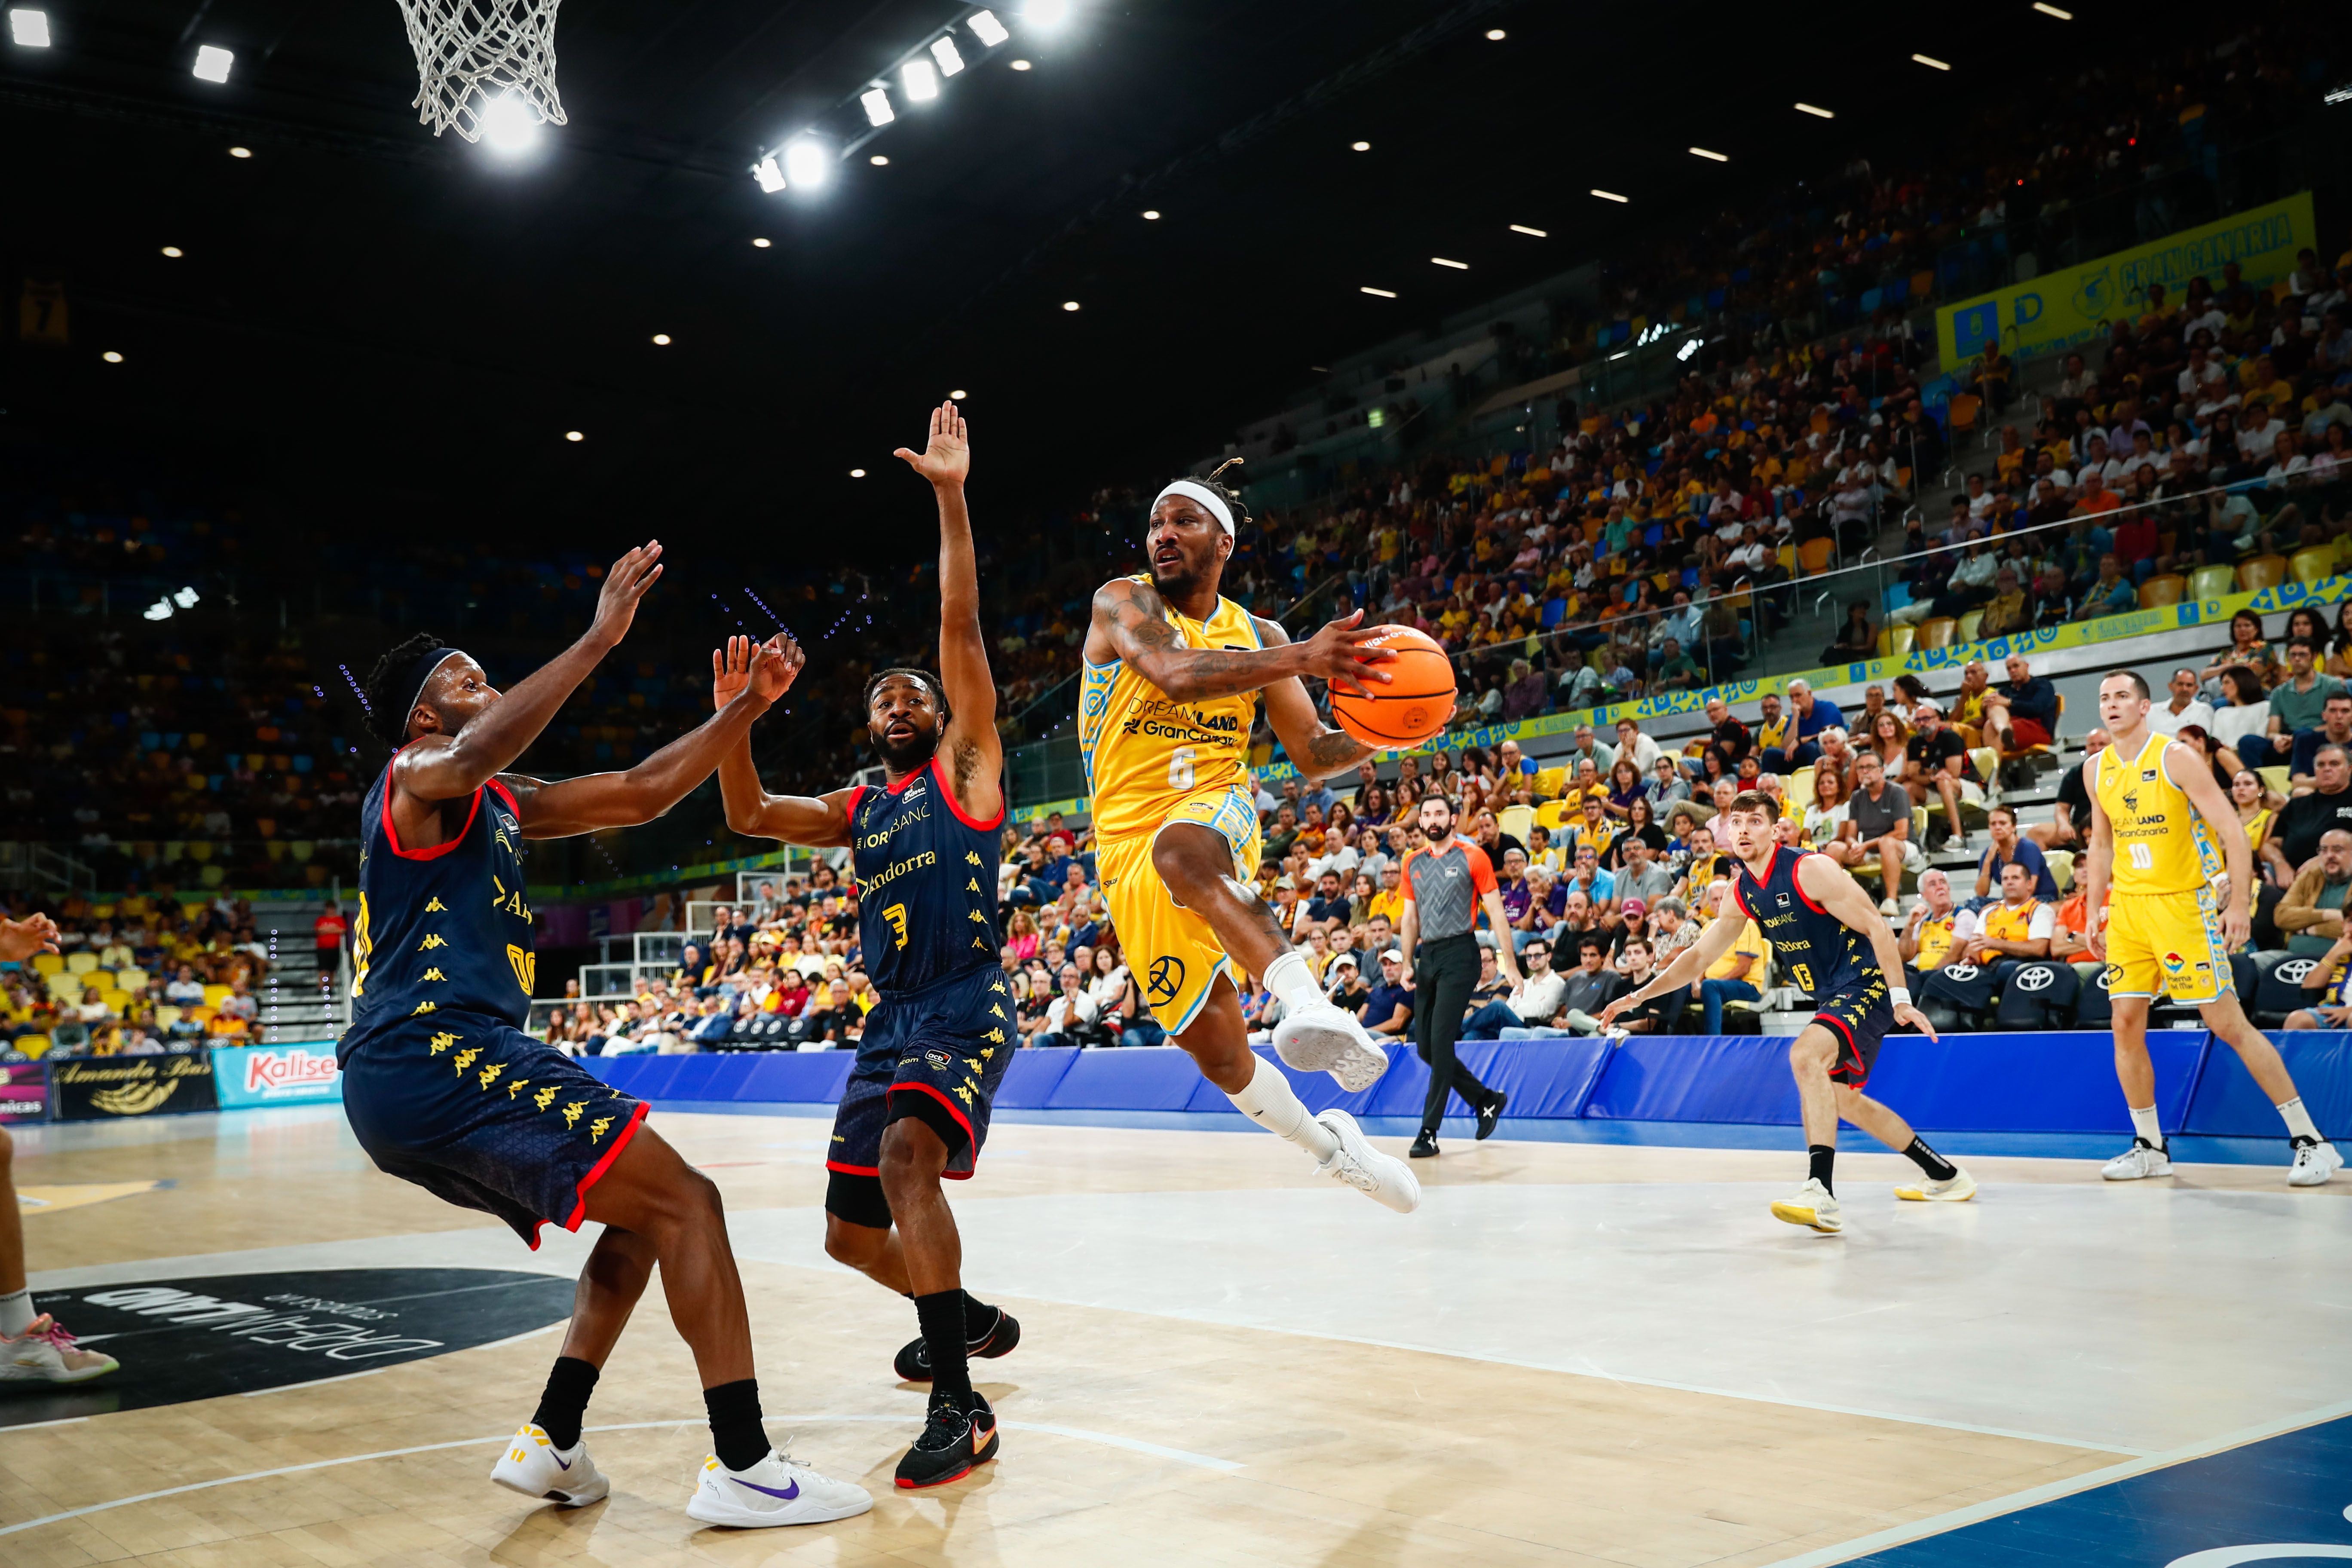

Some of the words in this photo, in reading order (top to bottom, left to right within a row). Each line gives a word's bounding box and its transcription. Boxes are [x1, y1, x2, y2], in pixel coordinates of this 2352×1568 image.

[2184, 212, 2294, 272] CANARIA
[1129, 697, 1238, 731] DREAMLAND
[1168, 748, 1196, 790] 6
[905, 787, 925, 800] endesa
[869, 850, 936, 895] Andorra
[2128, 843, 2153, 869] 10
[882, 902, 909, 952] 3
[1792, 963, 1815, 992] 13
[58, 1059, 157, 1084] Amanda
[250, 1054, 335, 1088] Kalise
[928, 1053, 943, 1061] acb
